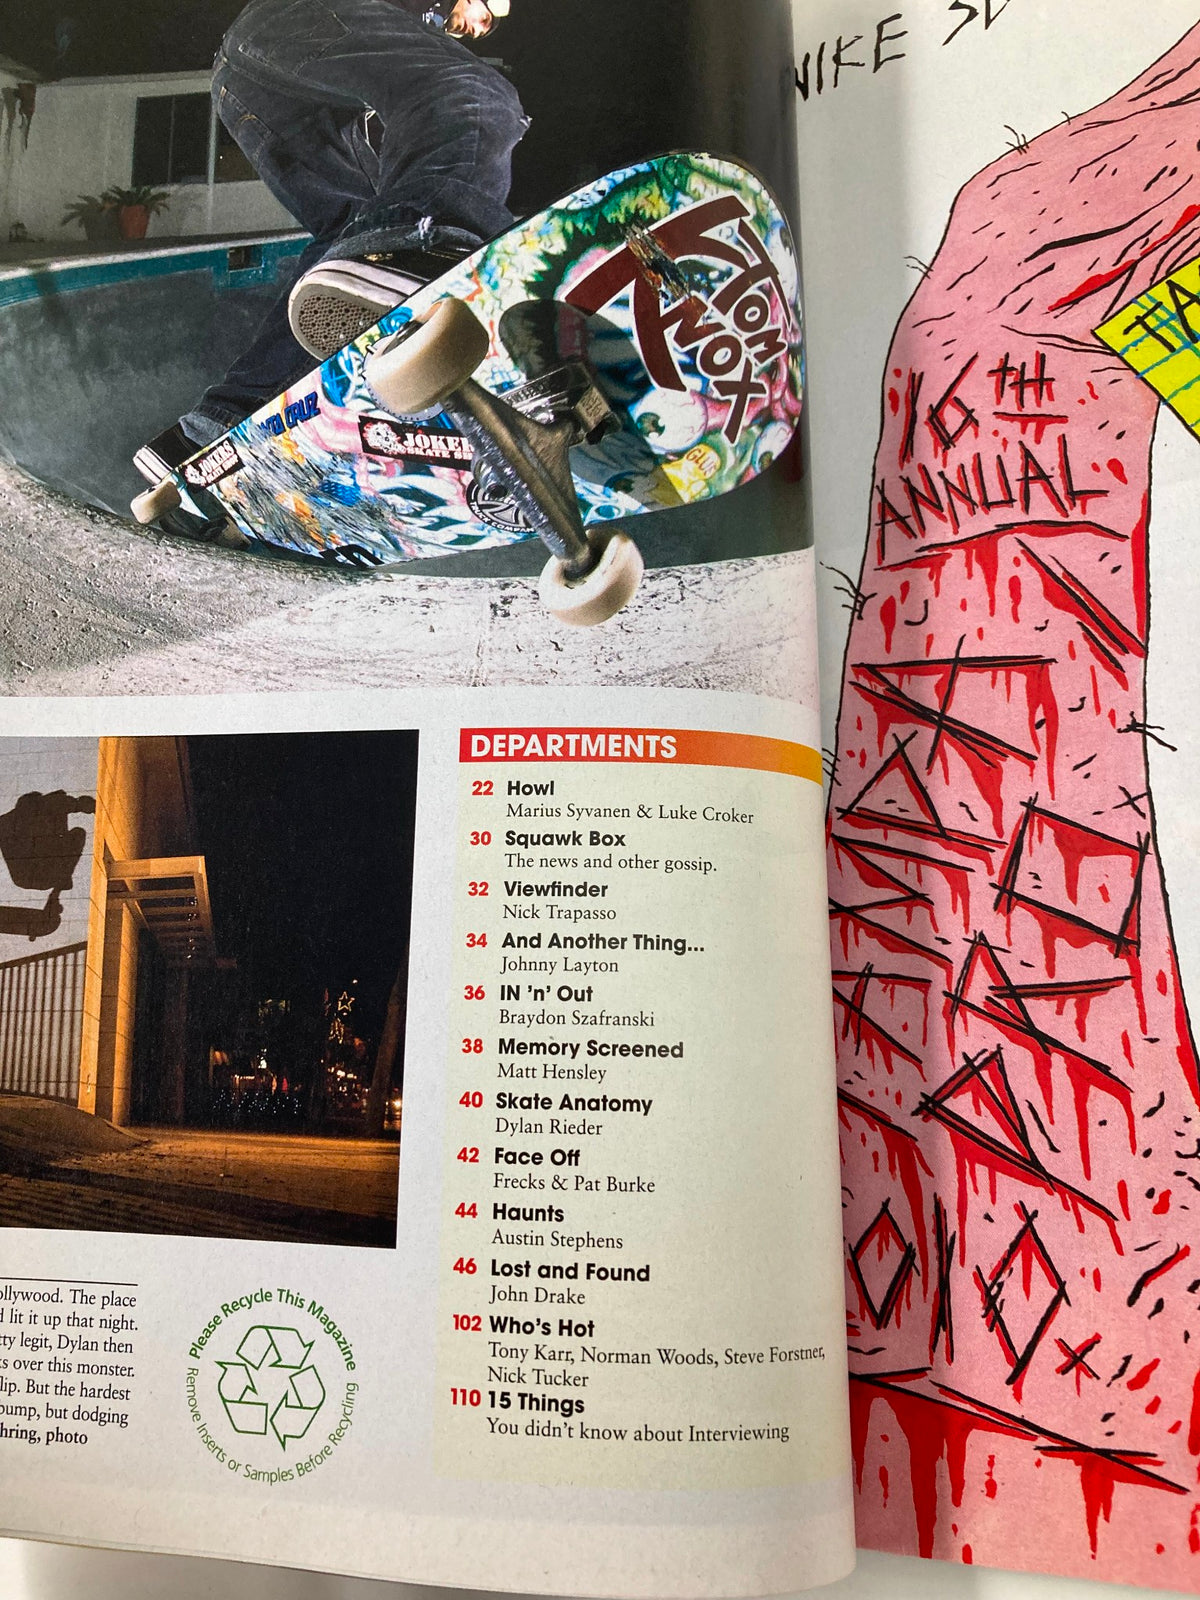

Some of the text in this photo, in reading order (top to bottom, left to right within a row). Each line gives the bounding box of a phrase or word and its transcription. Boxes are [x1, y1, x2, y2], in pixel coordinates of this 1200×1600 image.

[284, 391, 321, 429] CRUZ
[198, 440, 235, 476] JOKERS
[406, 446, 451, 459] SKATE
[206, 454, 240, 485] SKATE SHOP
[875, 433, 1110, 562] ANNUAL
[469, 501, 491, 523] TRUCK
[470, 734, 677, 759] DEPARTMENTS
[472, 781, 554, 795] 22 Howl
[507, 803, 753, 823] Marius Syvanen & Luke Croker
[470, 830, 626, 849] 30 Squawk Box
[505, 853, 716, 875] The news and other gossip.
[468, 881, 608, 897] 32 Viewfinder
[503, 904, 616, 923] Nick Trapasso
[466, 933, 704, 955] 34 And Another Thing...
[500, 956, 618, 975] Johnny Layton
[464, 985, 485, 1000] 36
[501, 985, 520, 1001] IN
[557, 985, 593, 1002] Out
[500, 1009, 654, 1028] Braydon Szafranski
[462, 1038, 683, 1059] 38 Memory Screened
[497, 1063, 606, 1084] Matt Hensley
[459, 1092, 652, 1116] 40 Skate Anatomy
[496, 1118, 602, 1137] Dylan Rieder
[457, 1147, 580, 1166] 42 Face Off
[494, 1173, 655, 1192] Frecks & Pat Burke
[455, 1203, 564, 1222] 44 Haunts
[492, 1229, 623, 1251] Austin Stephens
[453, 1258, 650, 1282] 46 Lost and Found
[70, 1289, 96, 1304] The
[101, 1291, 136, 1309] place
[489, 1285, 585, 1304] John Drake
[10, 1309, 23, 1324] lit
[29, 1310, 38, 1324] it
[44, 1316, 61, 1329] up
[67, 1312, 94, 1327] that
[99, 1314, 137, 1333] night.
[189, 1288, 355, 1371] Please Recycle This Magazine
[453, 1314, 595, 1337] 102 Who's Hot
[20, 1332, 52, 1351] legit,
[57, 1335, 98, 1353] Dylan
[104, 1337, 133, 1353] then
[488, 1341, 825, 1368] Tony Karr, Norman Woods, Steve Forstner,
[13, 1360, 43, 1370] over
[48, 1356, 72, 1373] this
[77, 1364, 134, 1377] monster.
[488, 1366, 589, 1387] Nick Tucker
[26, 1379, 50, 1394] But
[55, 1380, 75, 1396] the
[80, 1382, 131, 1400] hardest
[451, 1388, 584, 1418] 110 15 Things
[46, 1403, 68, 1419] but
[72, 1405, 128, 1428] dodging
[46, 1427, 88, 1445] photo
[187, 1368, 359, 1486] Remove Inserts or Samples Before Recycling
[487, 1417, 789, 1442] You didn't know about Interviewing
